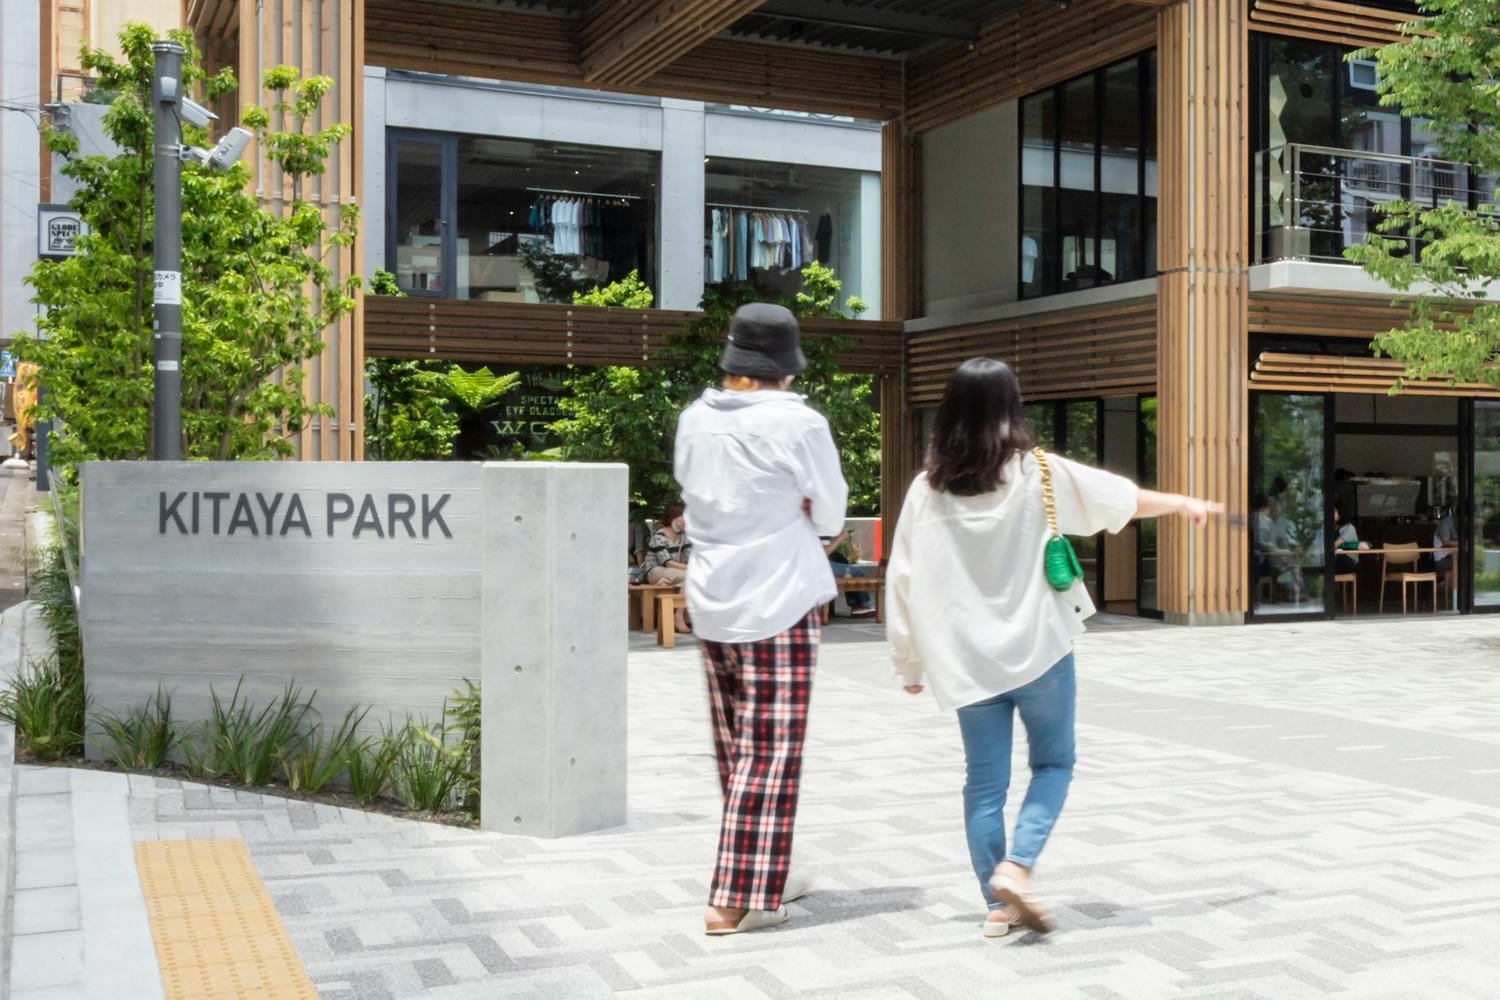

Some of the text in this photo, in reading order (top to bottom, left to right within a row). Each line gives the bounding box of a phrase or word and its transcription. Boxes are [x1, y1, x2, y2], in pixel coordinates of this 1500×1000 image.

[51, 223, 78, 231] GLOBE
[521, 395, 560, 405] SPECTA
[158, 491, 454, 539] KITAYA PARK
